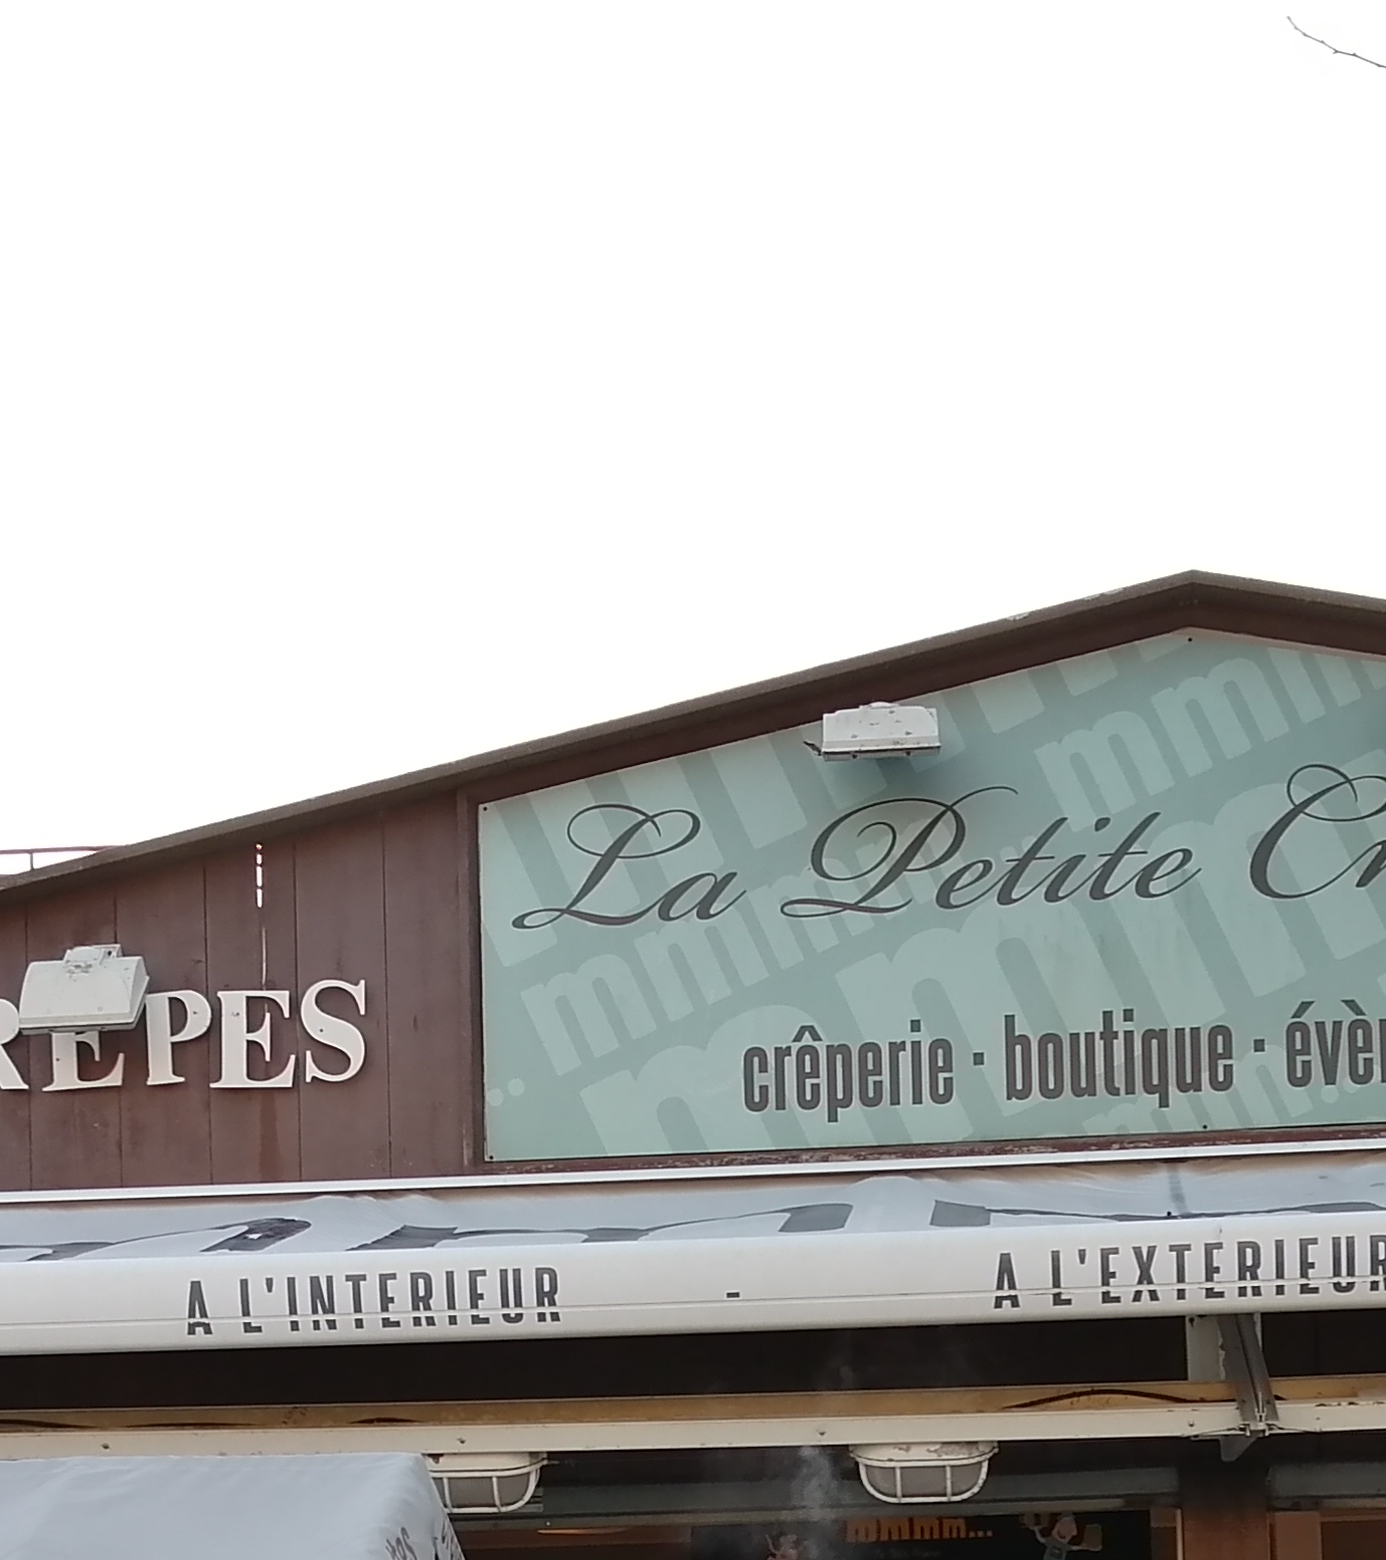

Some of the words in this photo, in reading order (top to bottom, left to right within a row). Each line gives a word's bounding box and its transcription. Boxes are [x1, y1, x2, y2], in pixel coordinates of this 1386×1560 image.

[512, 803, 745, 930] La
[780, 785, 1201, 918] Petite
[743, 1019, 955, 1123] crêperie
[1004, 1008, 1234, 1108] boutique
[186, 1279, 213, 1337] A
[240, 1267, 561, 1333] L'INTERIEUR
[993, 1252, 1021, 1310] A
